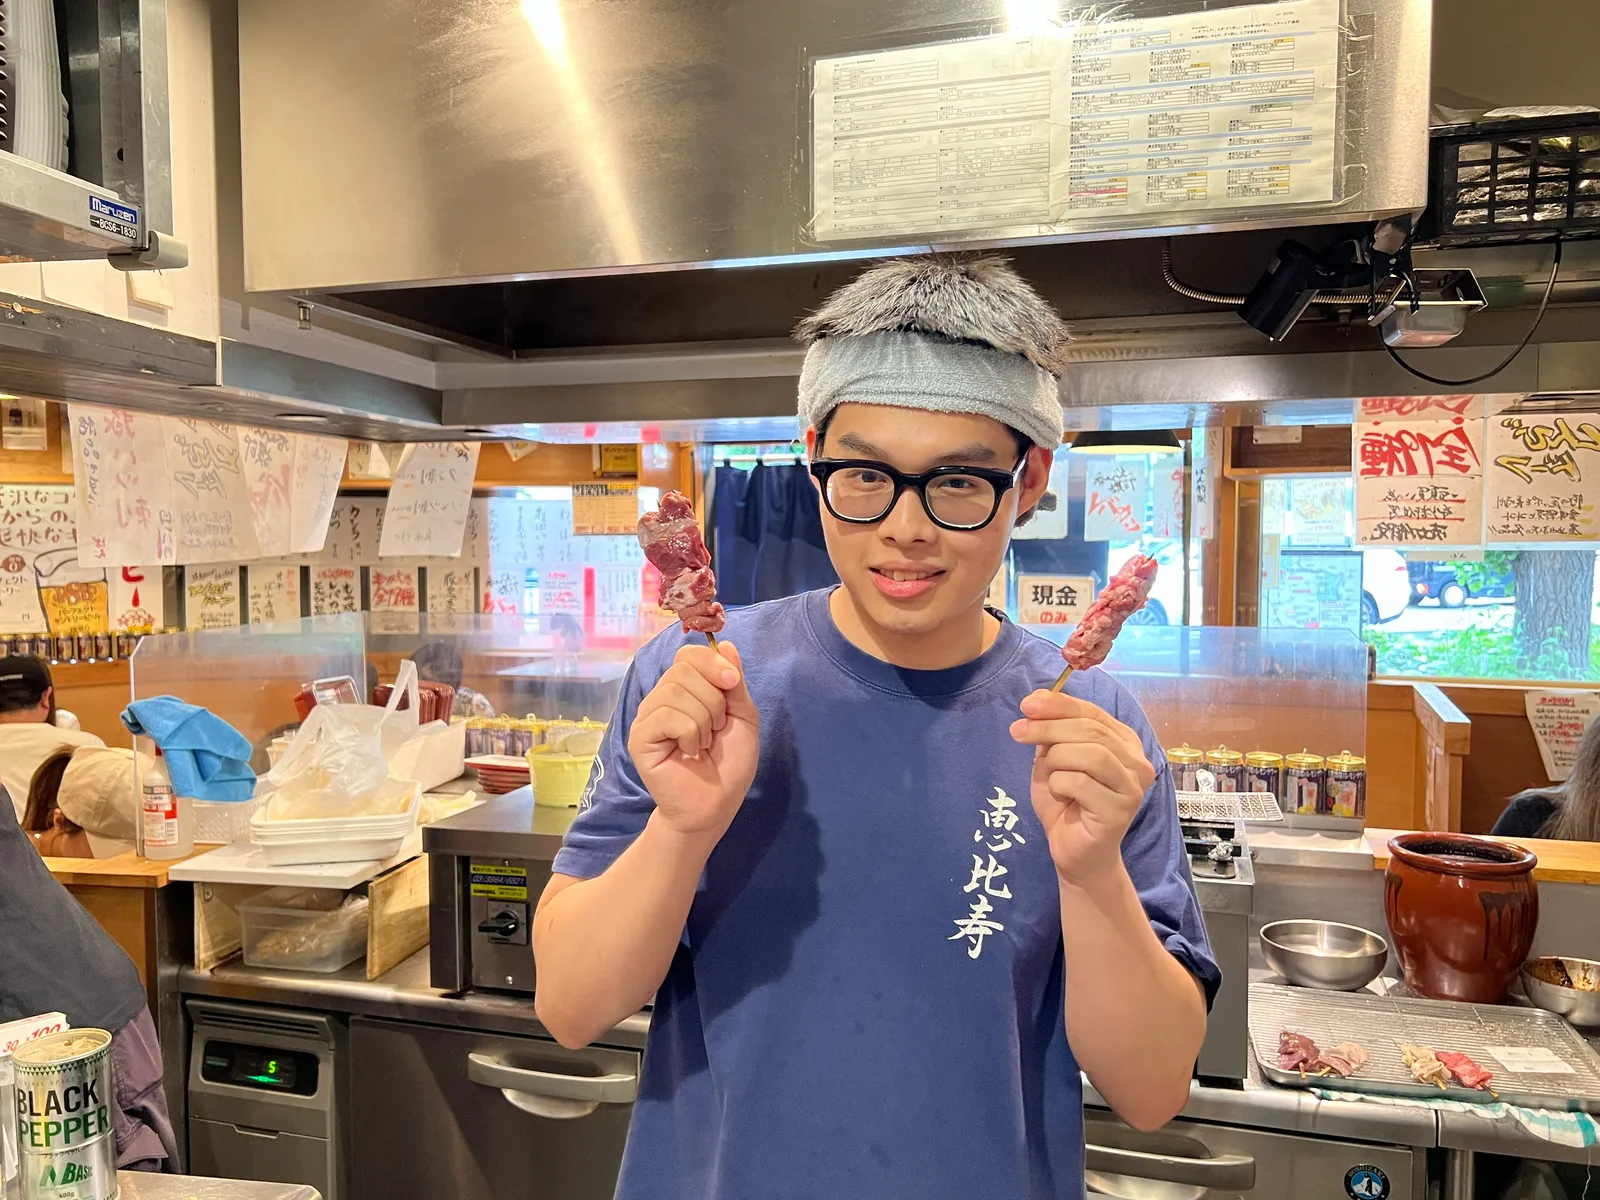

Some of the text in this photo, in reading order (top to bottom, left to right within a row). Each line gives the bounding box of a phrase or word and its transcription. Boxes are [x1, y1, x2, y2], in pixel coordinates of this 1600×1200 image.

[92, 198, 136, 223] Maruzen
[1032, 585, 1077, 606] 現金
[1040, 611, 1068, 624] のみ
[947, 786, 1026, 959] 恵比寿
[17, 1079, 99, 1117] BLACK
[19, 1105, 109, 1147] PEPPER
